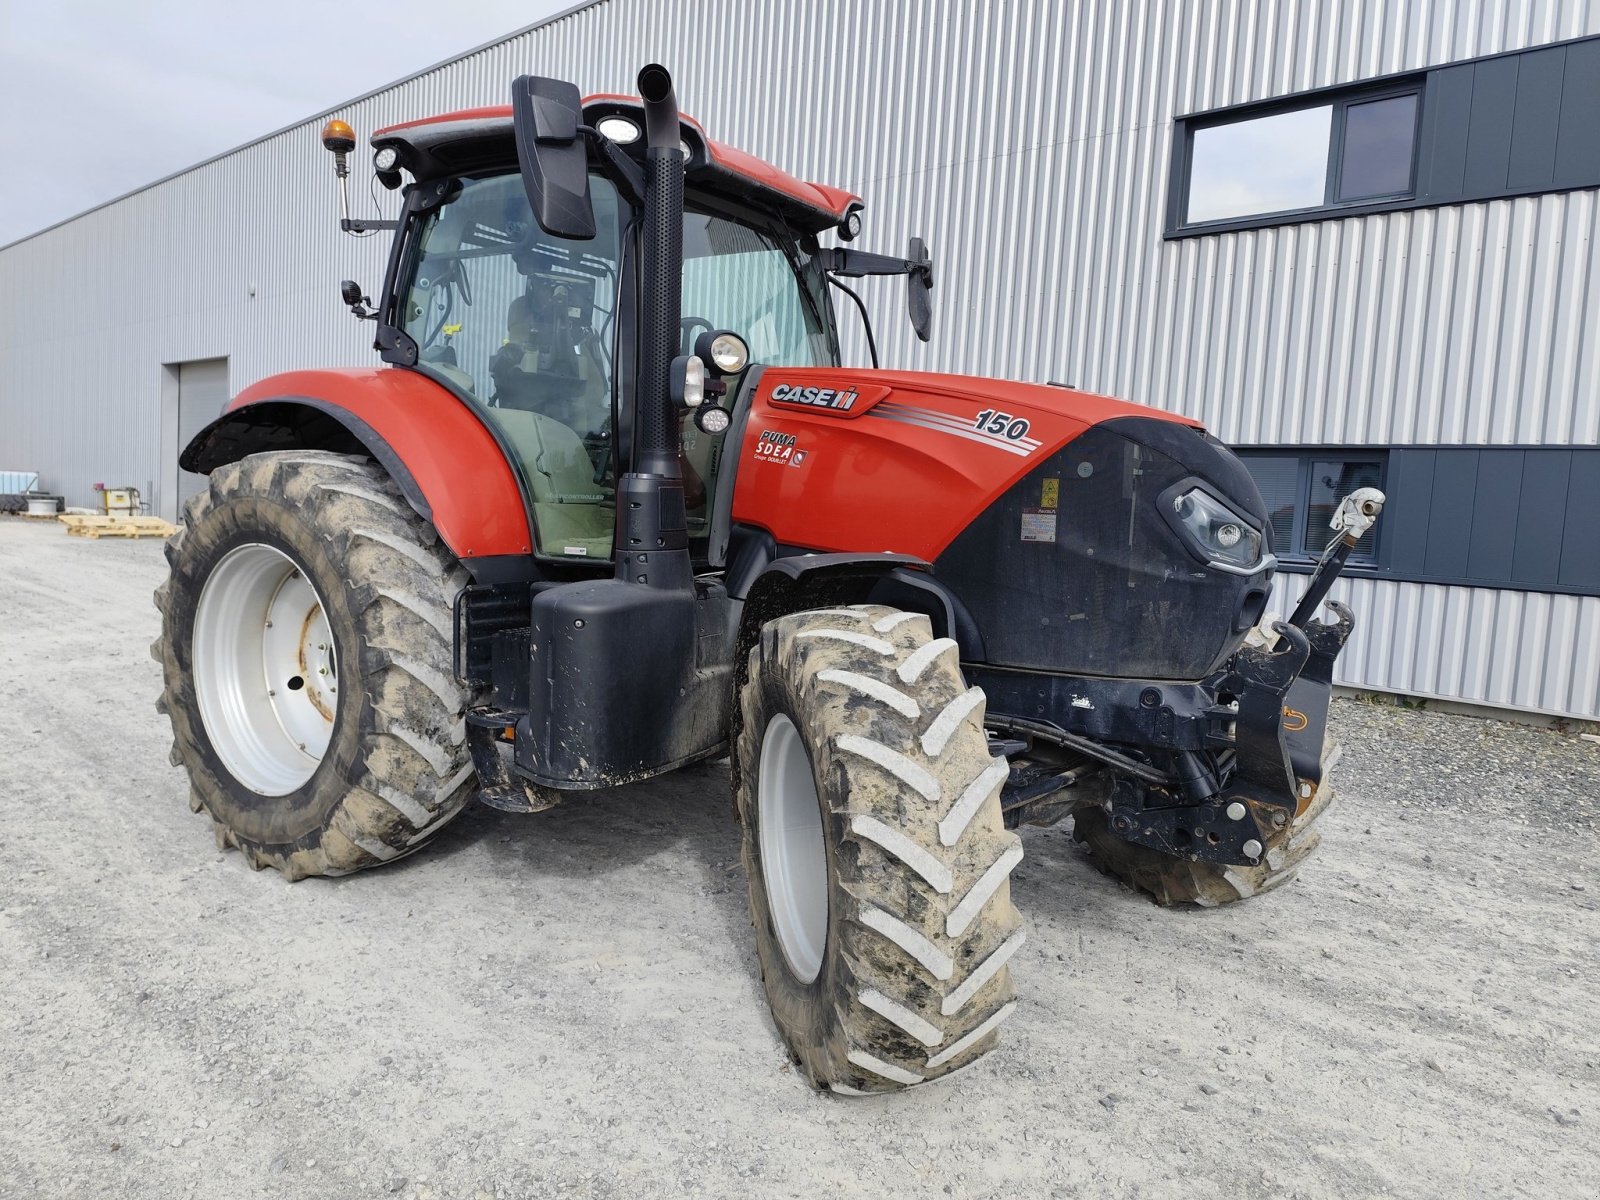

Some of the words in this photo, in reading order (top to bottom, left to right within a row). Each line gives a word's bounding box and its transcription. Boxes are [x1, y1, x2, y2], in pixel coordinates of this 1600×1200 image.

[770, 383, 835, 406] CASE
[974, 409, 1030, 441] 150
[760, 430, 797, 446] PUMA
[755, 442, 792, 458] SDEA
